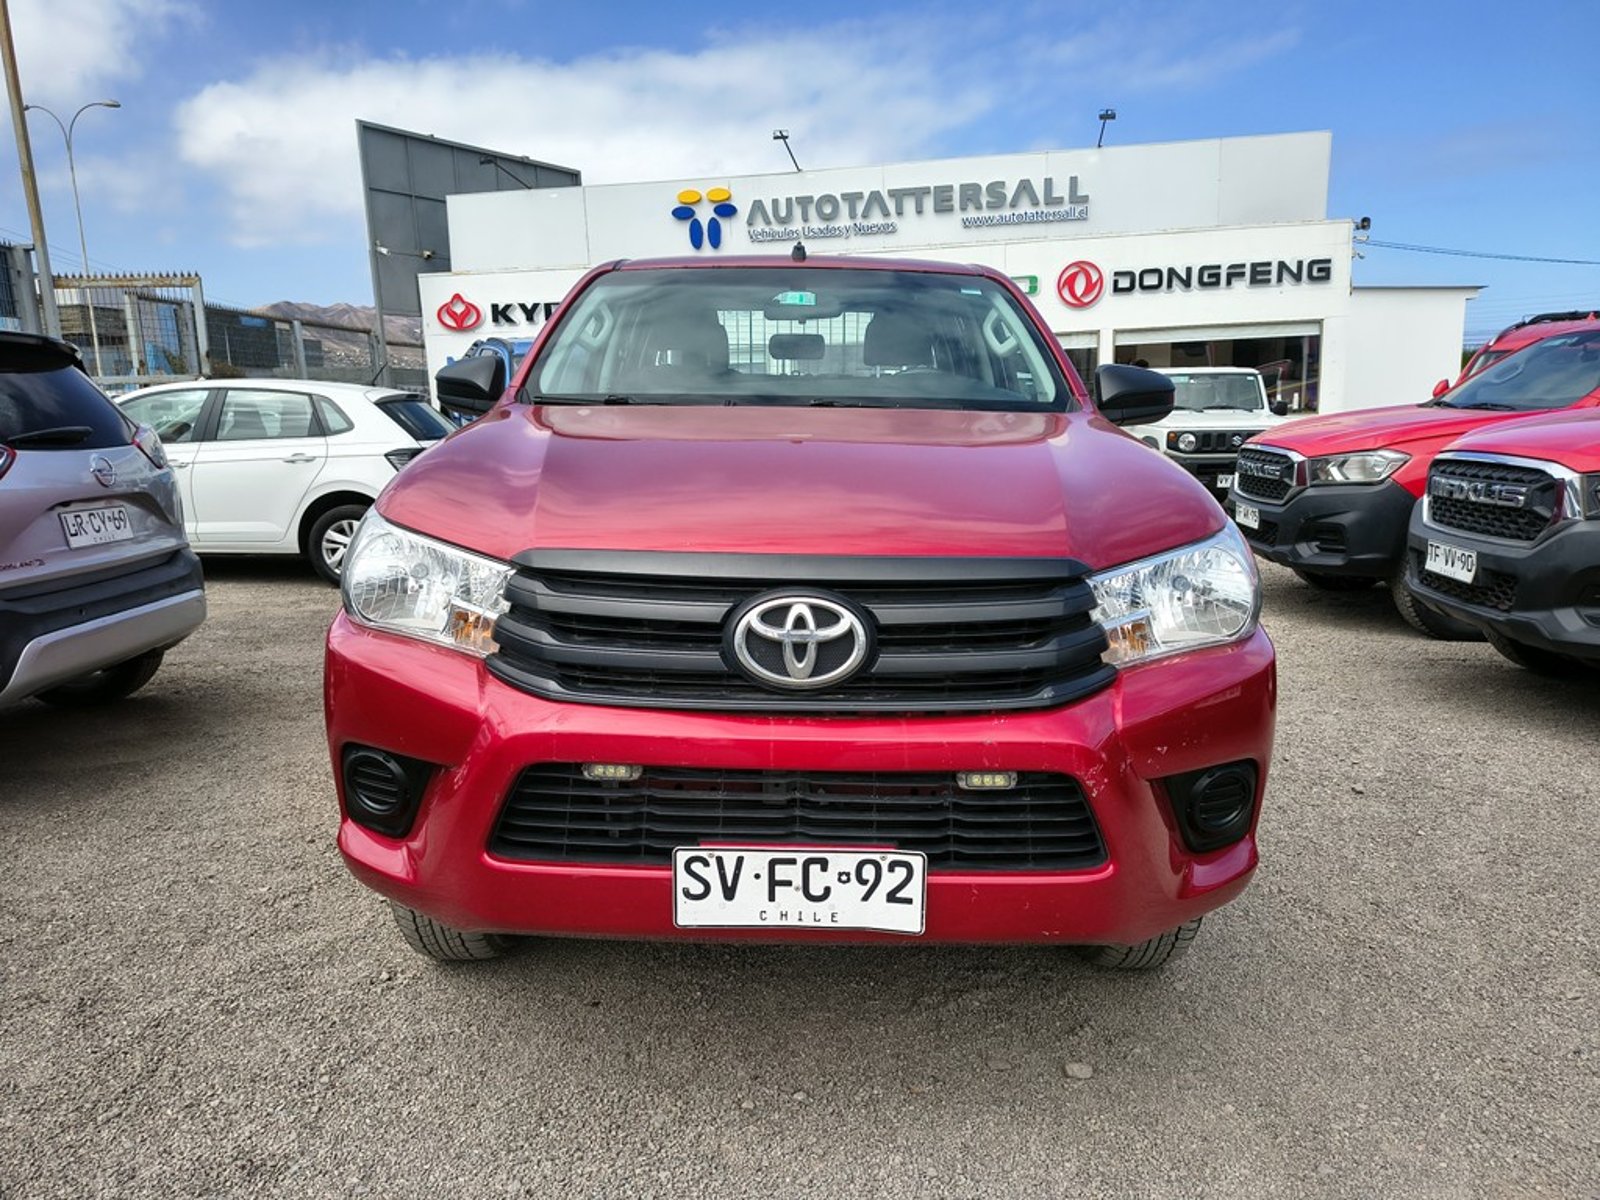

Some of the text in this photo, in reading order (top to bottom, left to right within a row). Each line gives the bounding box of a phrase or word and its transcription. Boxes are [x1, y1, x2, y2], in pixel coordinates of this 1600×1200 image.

[746, 176, 1090, 225] AUTOTATTERSALL
[801, 225, 844, 239] Usados
[844, 224, 851, 239] y
[852, 220, 897, 236] Nuevos
[1112, 258, 1332, 294] DONGFENG
[759, 910, 838, 923] CHILE
